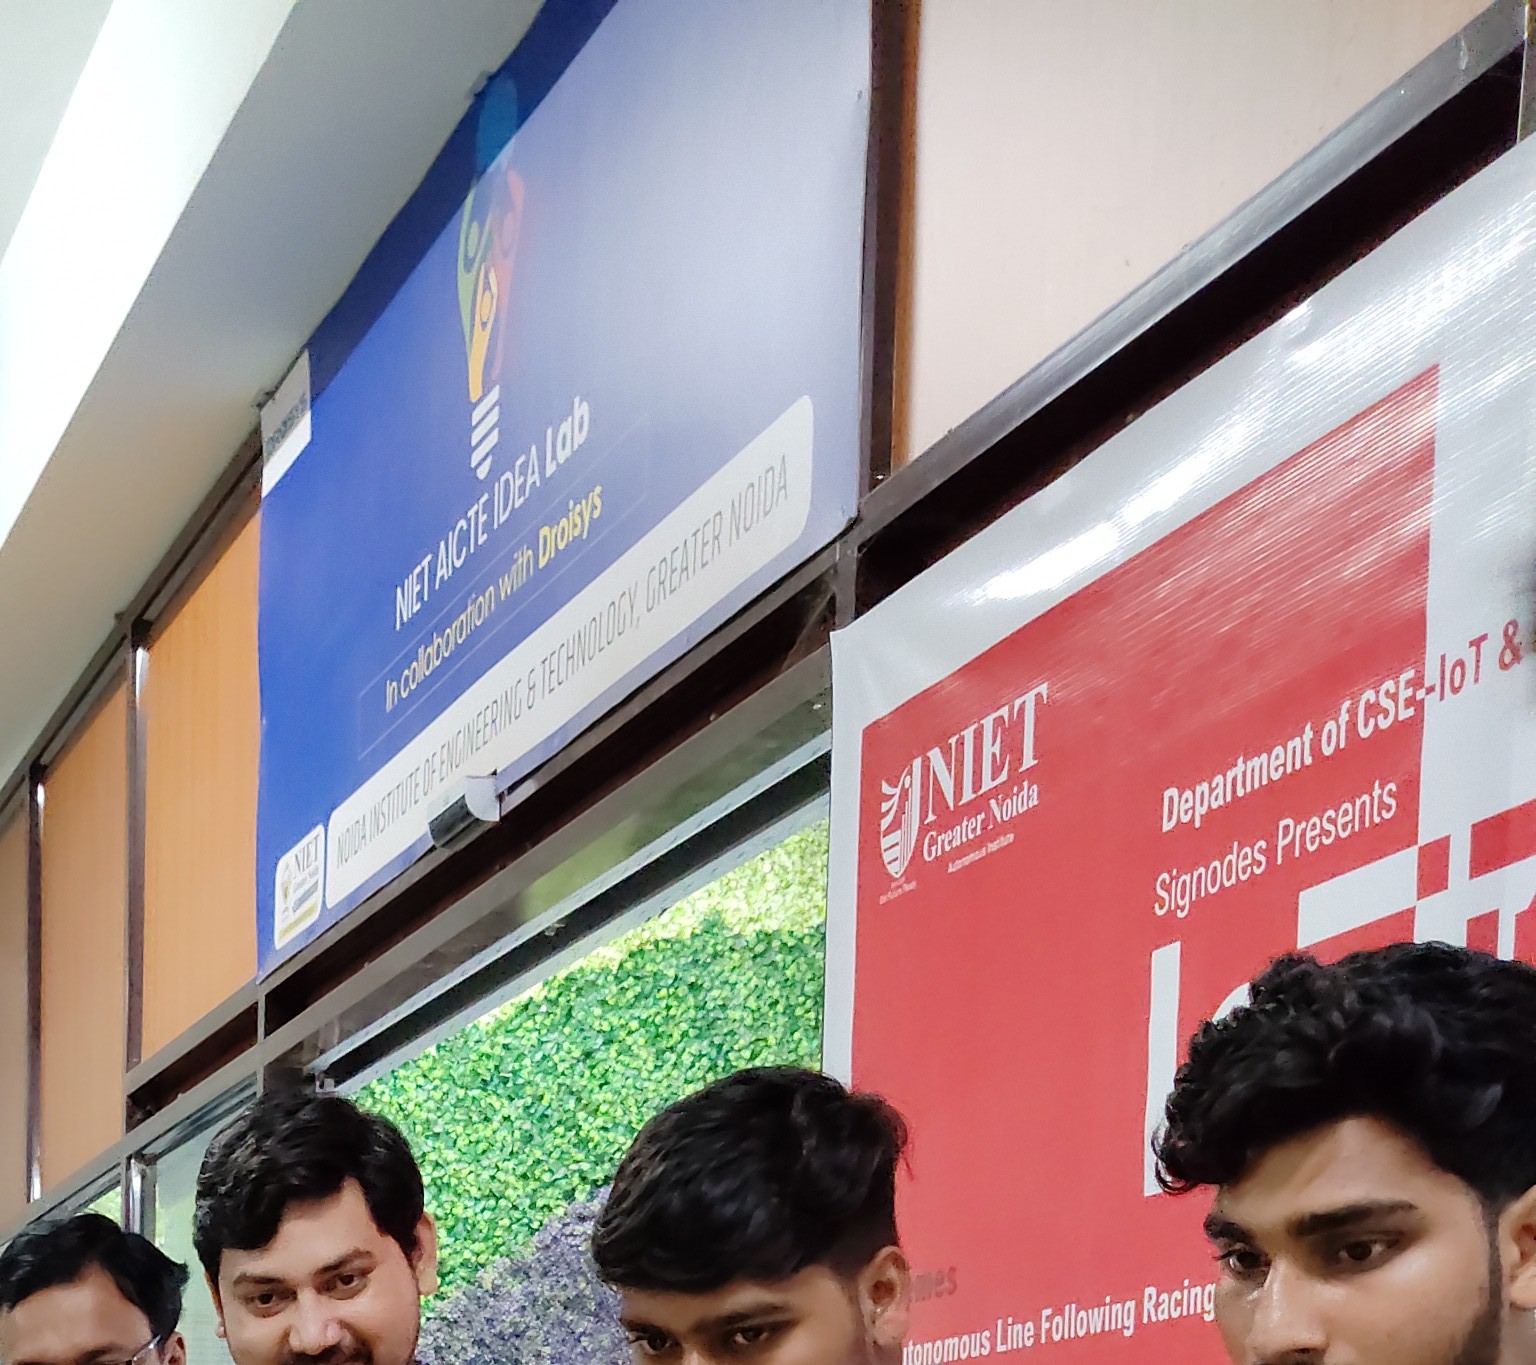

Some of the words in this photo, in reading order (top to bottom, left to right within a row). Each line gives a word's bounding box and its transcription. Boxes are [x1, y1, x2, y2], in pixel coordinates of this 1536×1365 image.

[386, 679, 398, 712] In
[400, 585, 496, 698] collaboration
[499, 544, 534, 601] with
[538, 485, 602, 569] Droisys
[395, 554, 433, 630] NIET
[435, 493, 489, 590] AICTE
[494, 444, 540, 530] IDEA
[545, 396, 590, 478] Lab
[336, 814, 368, 870] NOIDA
[369, 766, 420, 842] INSTITUTE
[422, 752, 437, 797] OF
[439, 678, 522, 782] ENGINEERING
[527, 668, 536, 710] &
[540, 580, 641, 700] TECHNOLOGY,
[646, 510, 723, 613] GREATER
[729, 454, 788, 546] NOIDA
[1162, 722, 1314, 832] Department
[1321, 700, 1354, 756] of
[1498, 619, 1525, 671] &
[923, 812, 986, 862] Greater
[988, 779, 1039, 829] Noida
[924, 682, 1049, 824] NIET
[1155, 839, 1267, 918] Signodes
[1277, 778, 1398, 864] Presents
[996, 1316, 1035, 1352] Line
[1040, 1295, 1136, 1344] Following
[1142, 1279, 1217, 1325] Racing
